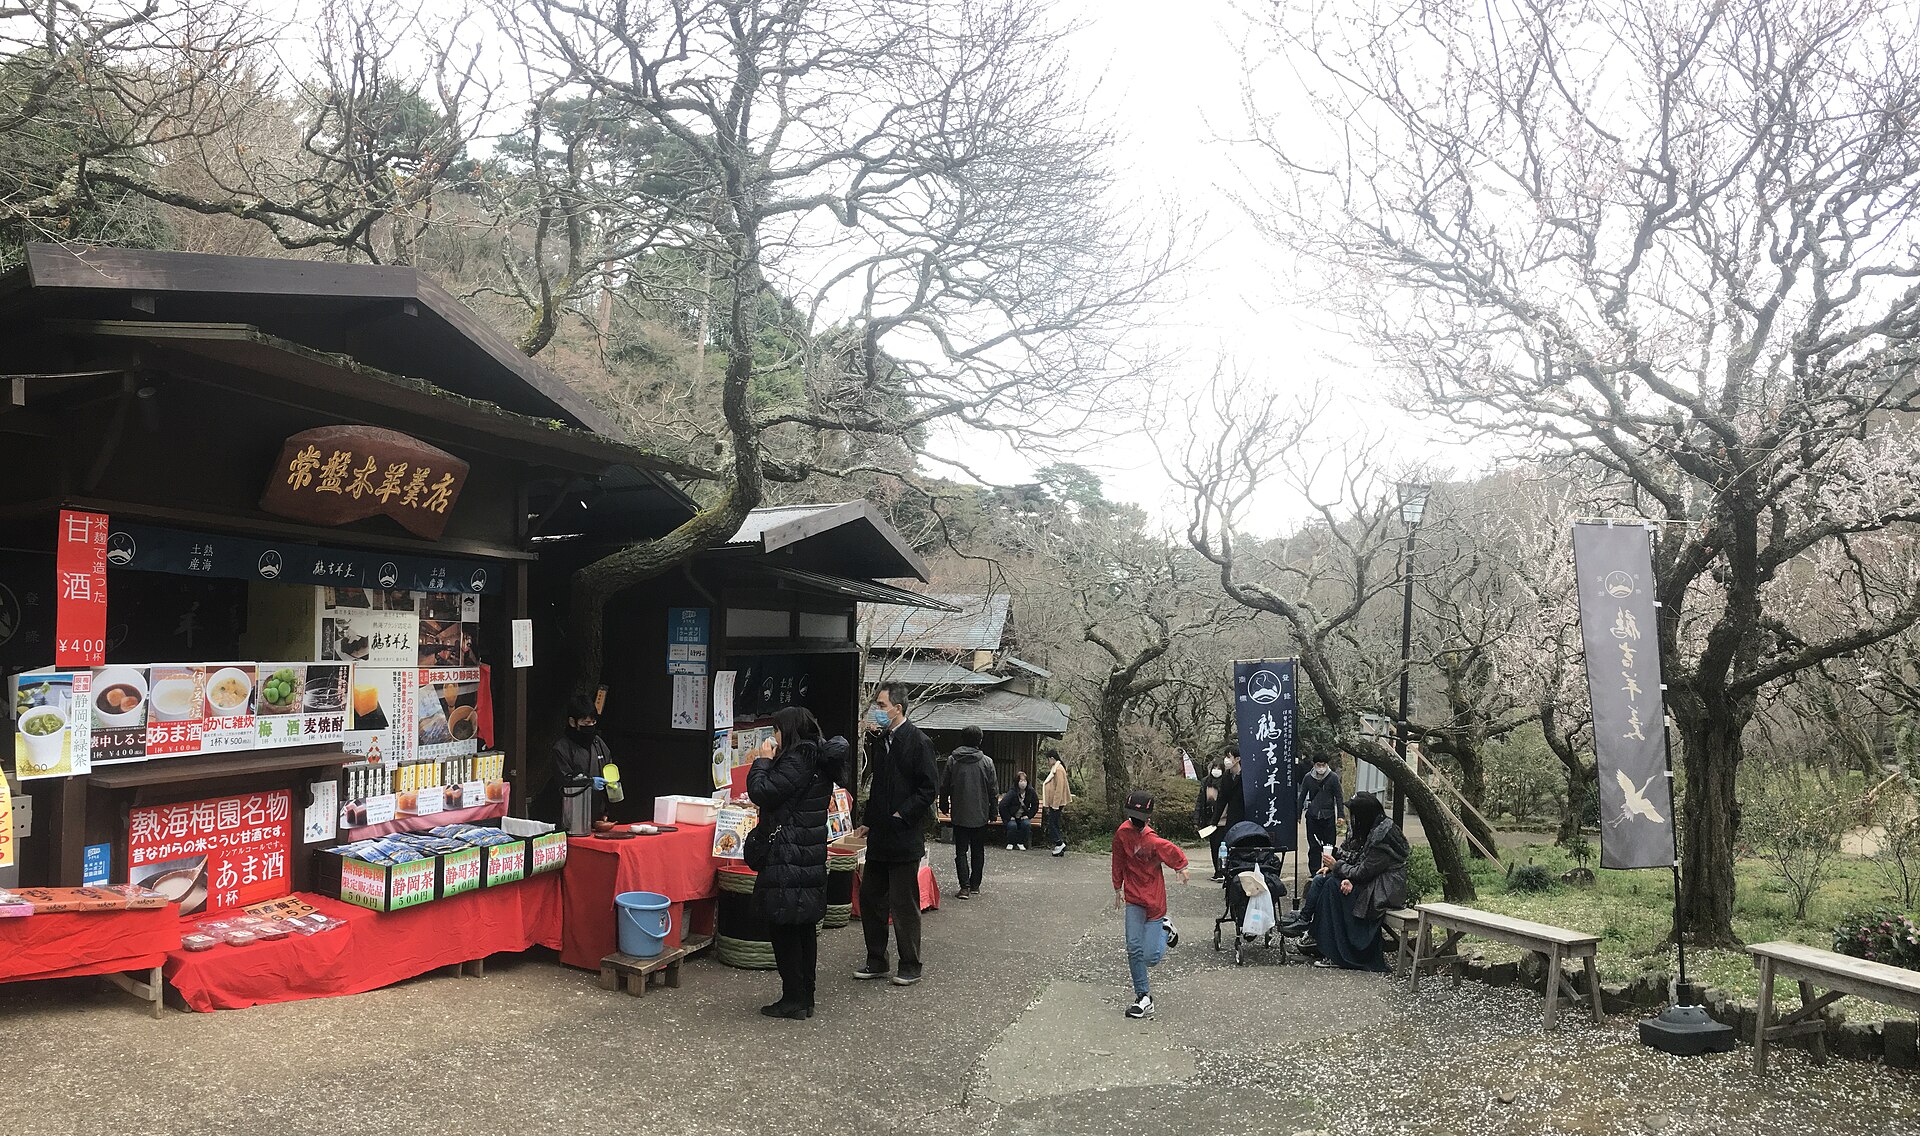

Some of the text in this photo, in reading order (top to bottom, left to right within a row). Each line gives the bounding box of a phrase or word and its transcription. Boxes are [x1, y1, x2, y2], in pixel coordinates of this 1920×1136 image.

[288, 445, 455, 514] 常盤木羊羹店
[62, 515, 93, 600] 甘酒
[92, 517, 108, 603] 米麹で造った
[59, 639, 104, 652] ¥400
[84, 653, 102, 661] 1杯
[73, 694, 89, 768] 静岡冷緑茶
[208, 715, 255, 730] かに雑炊
[258, 719, 300, 738] 梅酒
[304, 716, 344, 735] 麦焼酎
[152, 723, 203, 744] あま酒
[210, 737, 223, 747] 1杯
[19, 763, 48, 773] ¥400
[131, 792, 289, 846] 熱海梅園名物
[132, 825, 287, 864] 昔ながらの米こうじ甘酒です。
[219, 840, 285, 859] ノンアルコールです。
[488, 852, 524, 876] 静岡茶
[534, 843, 567, 867] 静岡茶
[216, 849, 285, 889] あま酒
[343, 860, 384, 883] 熱海梅園
[446, 860, 479, 886] 静岡茶
[494, 870, 520, 884] 500円
[342, 877, 384, 897] 限定販売品
[392, 870, 434, 897] 静岡茶
[217, 890, 239, 907] 1杯
[348, 891, 378, 908] 500円
[398, 890, 428, 906] 500円
